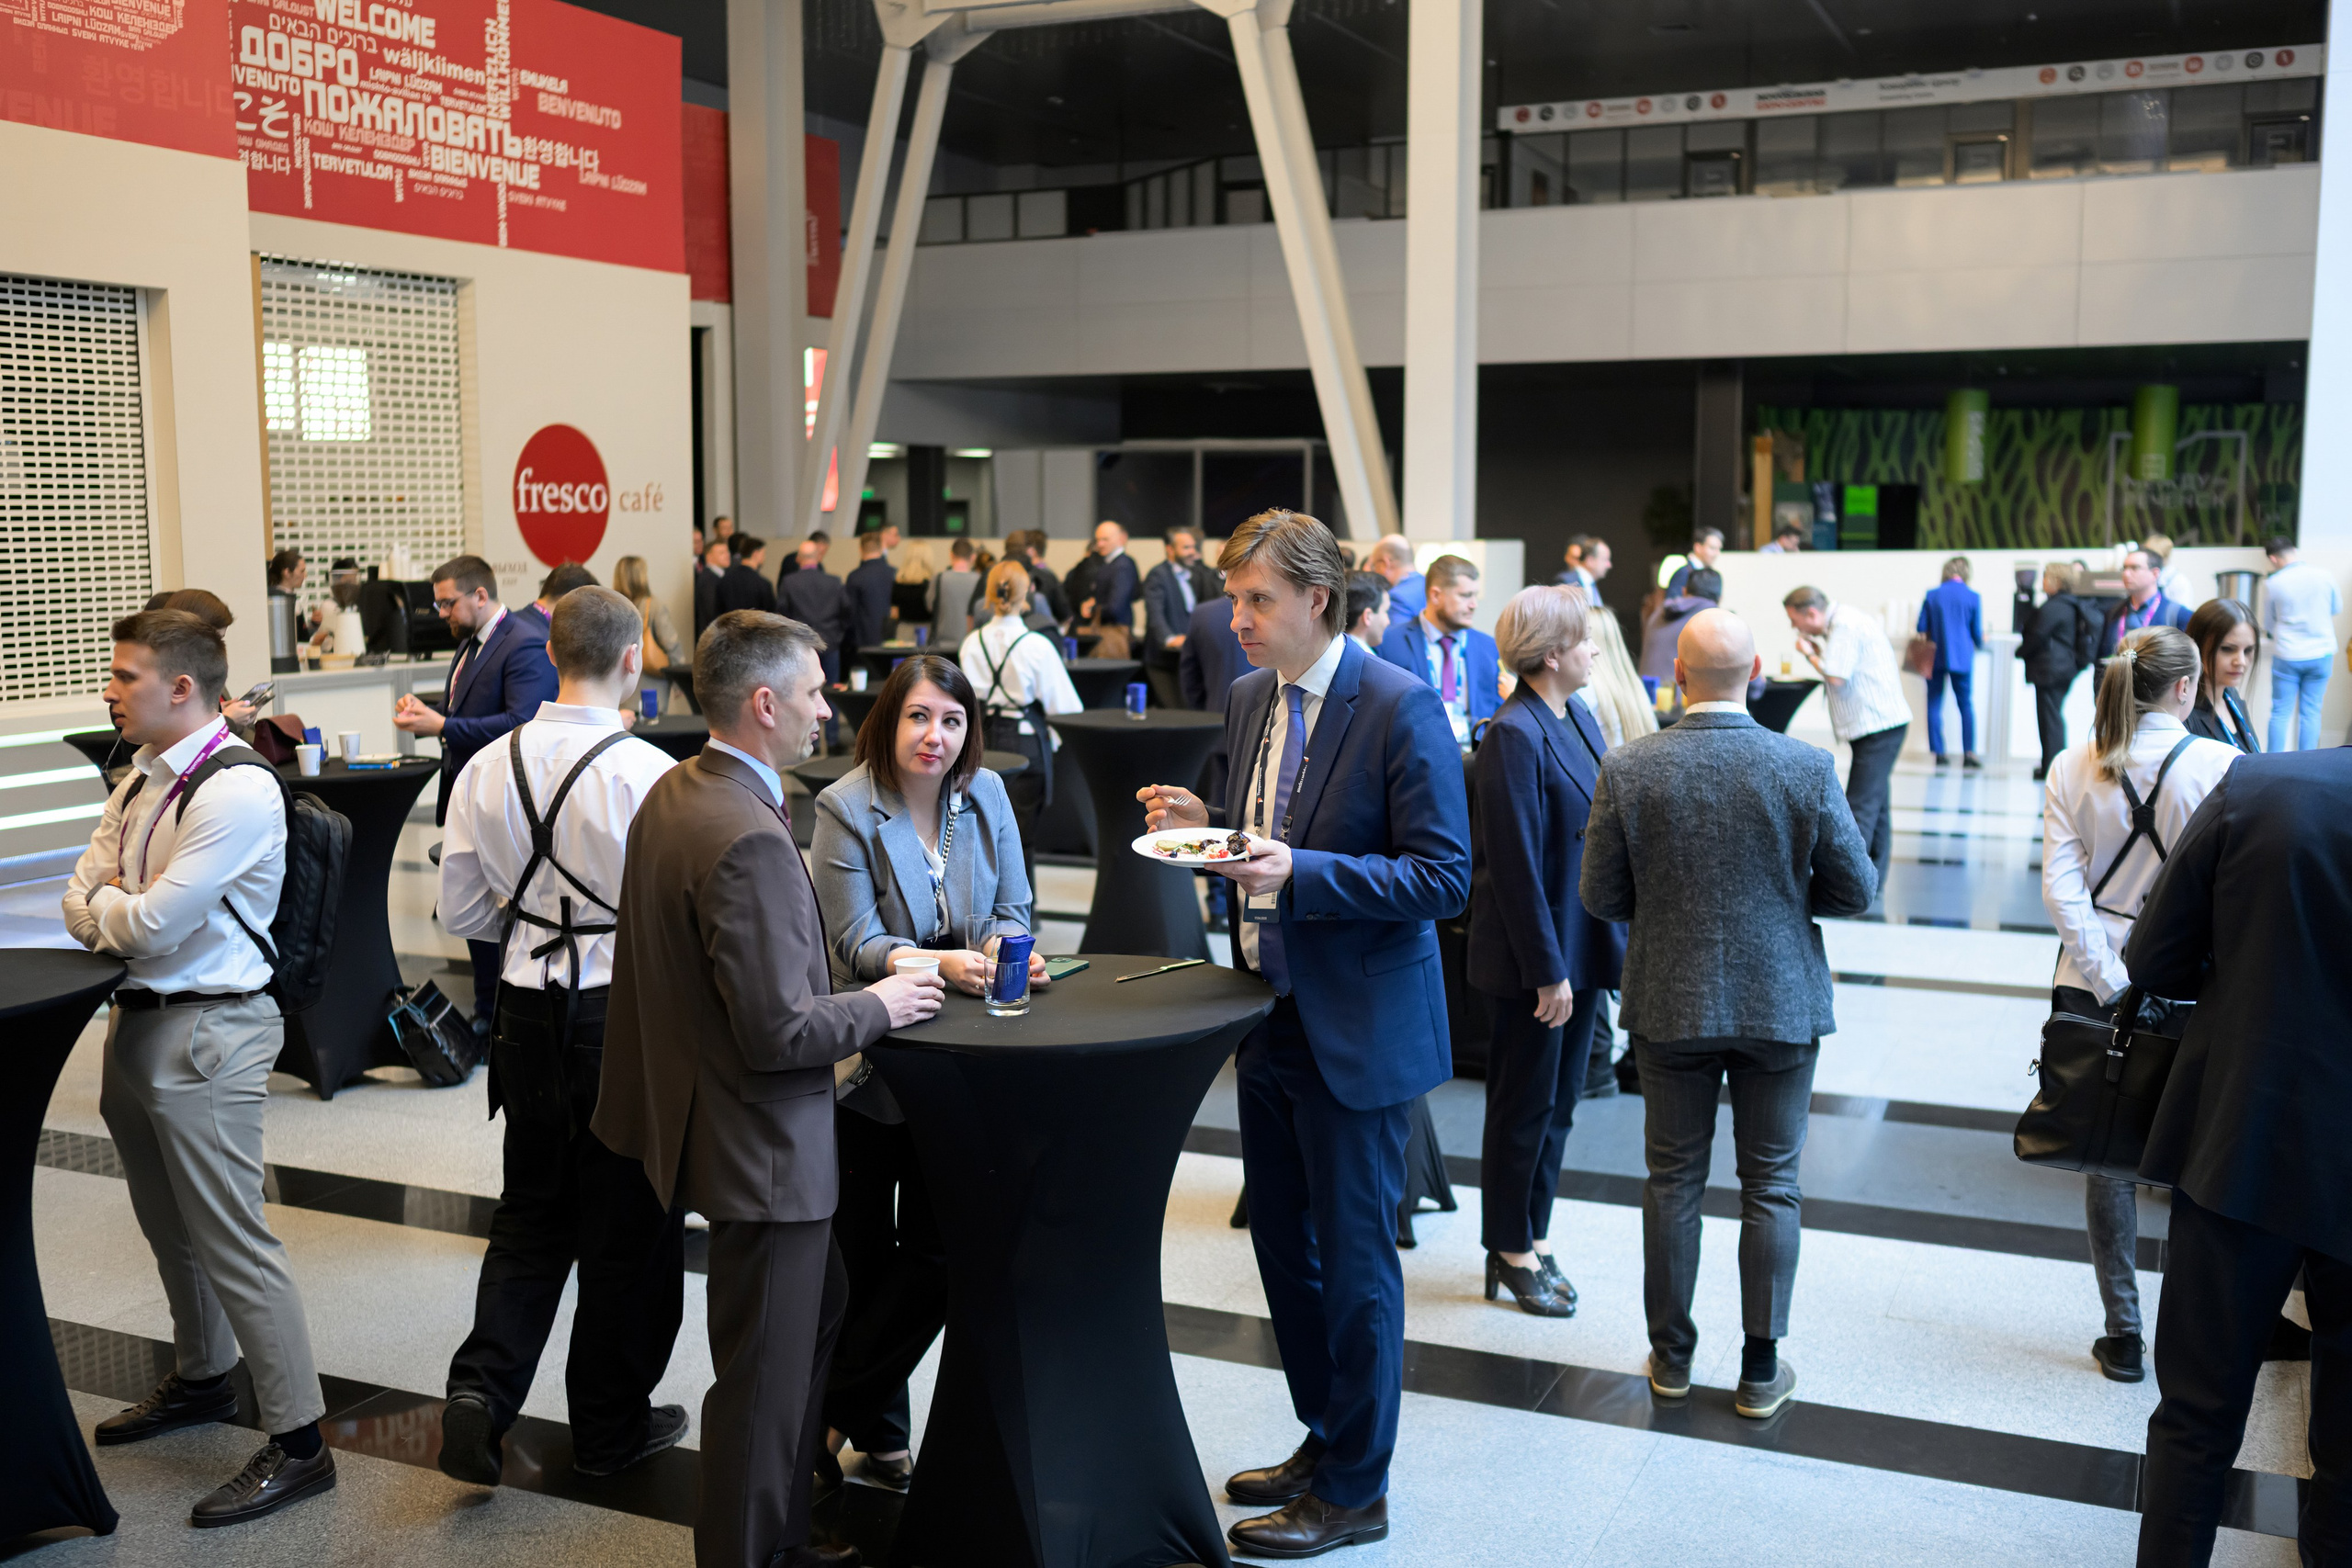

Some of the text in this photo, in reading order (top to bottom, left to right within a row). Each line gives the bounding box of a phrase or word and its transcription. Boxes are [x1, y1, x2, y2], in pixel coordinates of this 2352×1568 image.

[98, 34, 130, 49] ATVYKE
[313, 0, 435, 49] WELCOME
[240, 25, 359, 88] ДОБРО
[496, 0, 511, 119] WILLKOMME
[302, 78, 522, 160] ПОЖАЛОВАТЬ
[312, 152, 393, 182] TERVETULOA
[430, 143, 540, 190] BIENVENUE
[516, 467, 664, 514] fresco café
